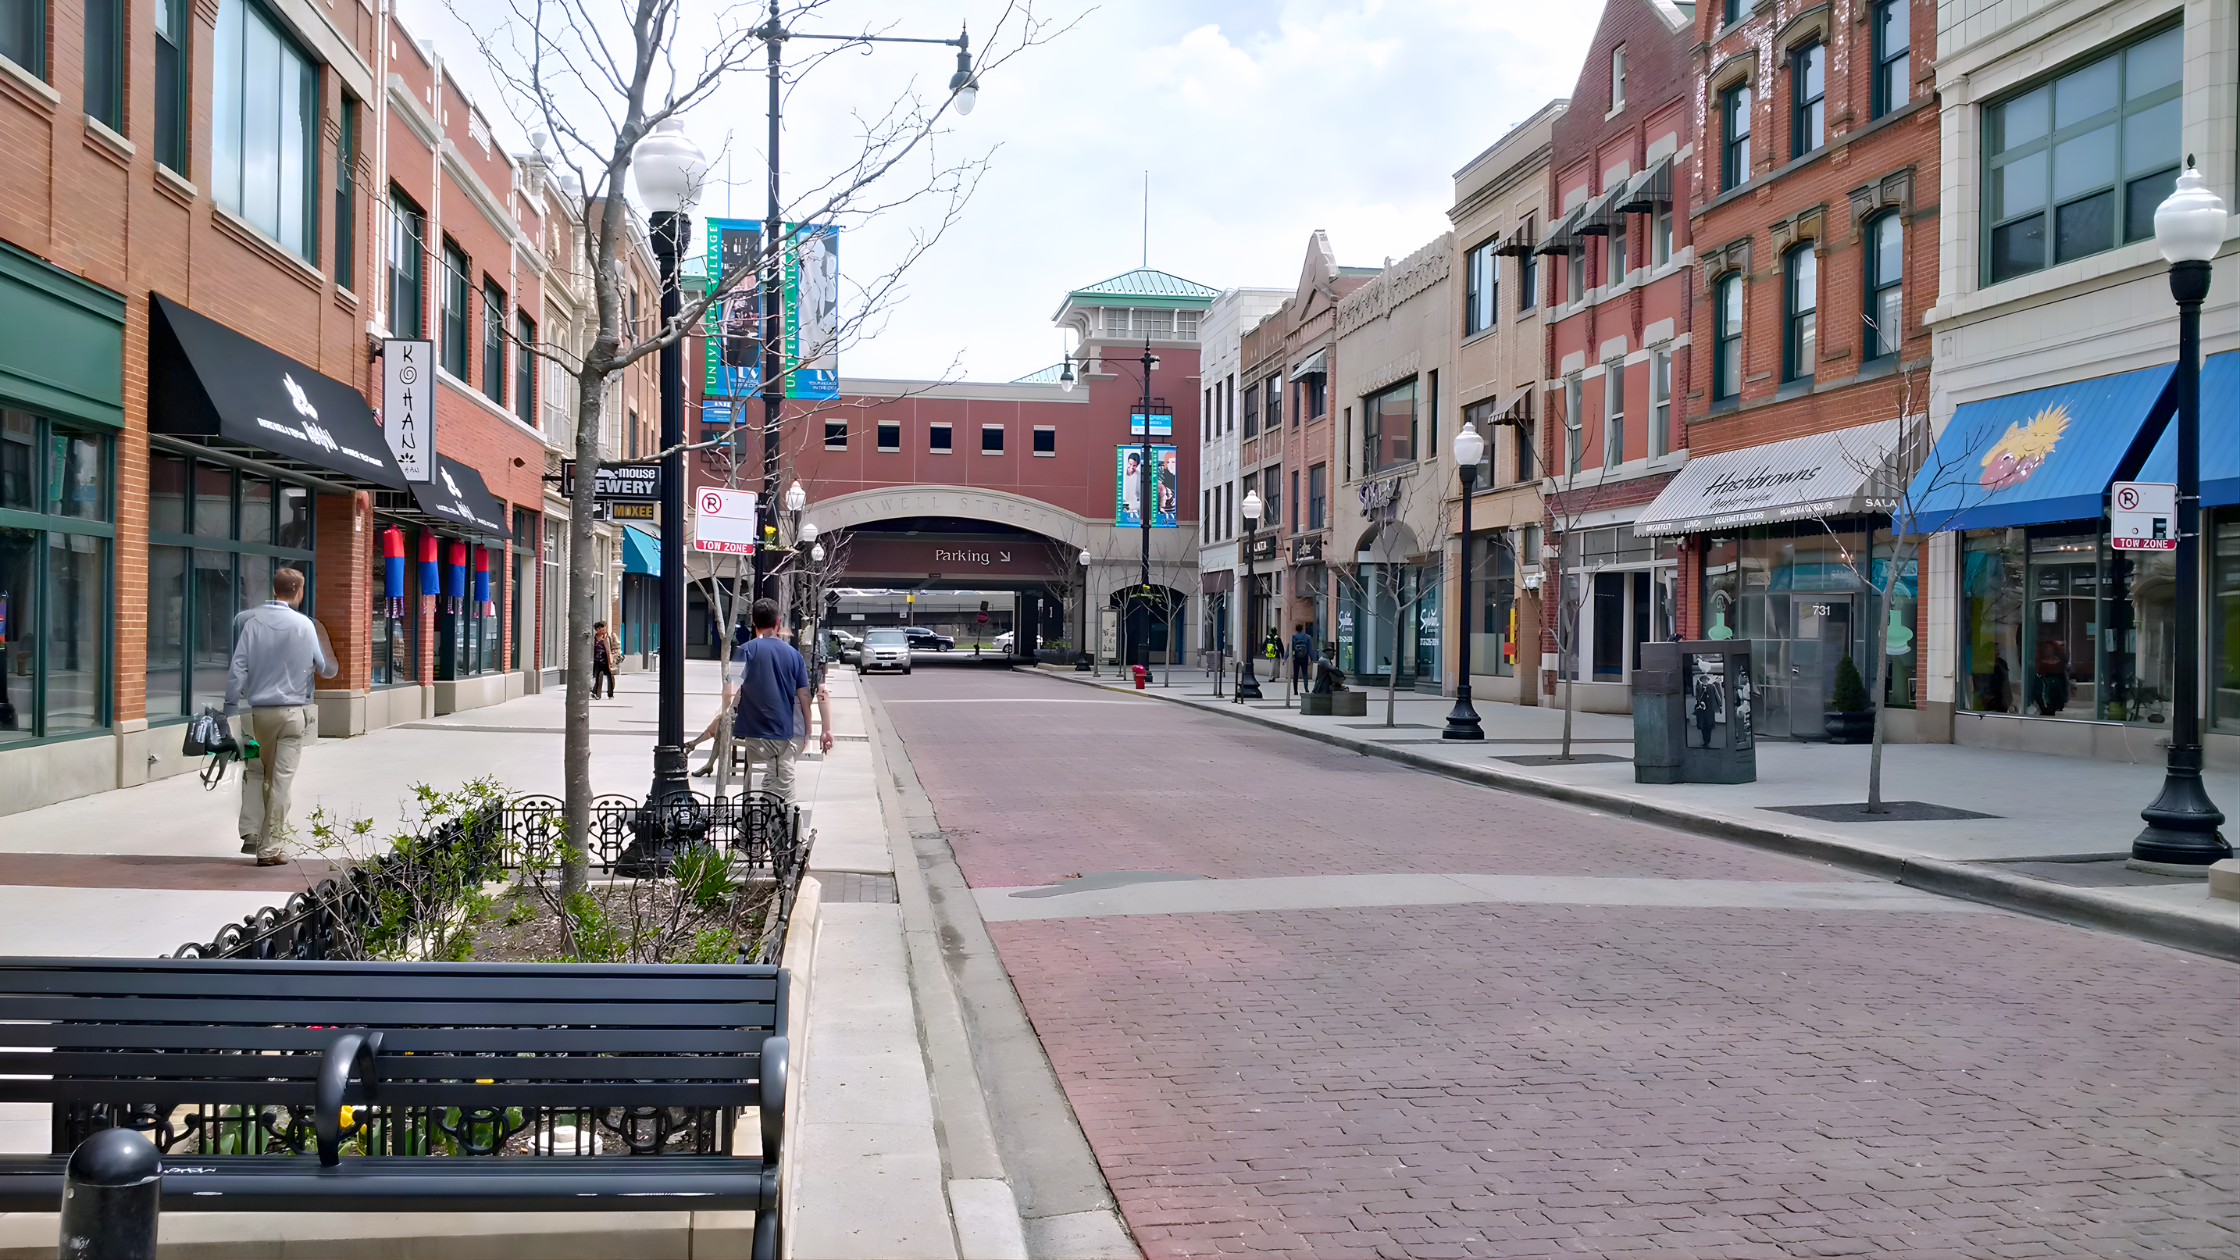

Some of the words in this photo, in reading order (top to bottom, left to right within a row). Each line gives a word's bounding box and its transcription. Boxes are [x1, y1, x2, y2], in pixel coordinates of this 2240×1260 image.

[618, 467, 656, 479] mouse
[571, 478, 655, 494] EWERY
[1702, 465, 1822, 497] Hashbrowns
[613, 505, 653, 517] MOXEE
[830, 496, 941, 518] MAXWELL
[959, 497, 1048, 525] STREET
[702, 540, 721, 551] TOW
[724, 542, 748, 553] ZONE
[2120, 538, 2140, 547] TOW
[2143, 539, 2169, 549] ZONE
[935, 549, 990, 565] Parking
[1812, 605, 1831, 616] 731
